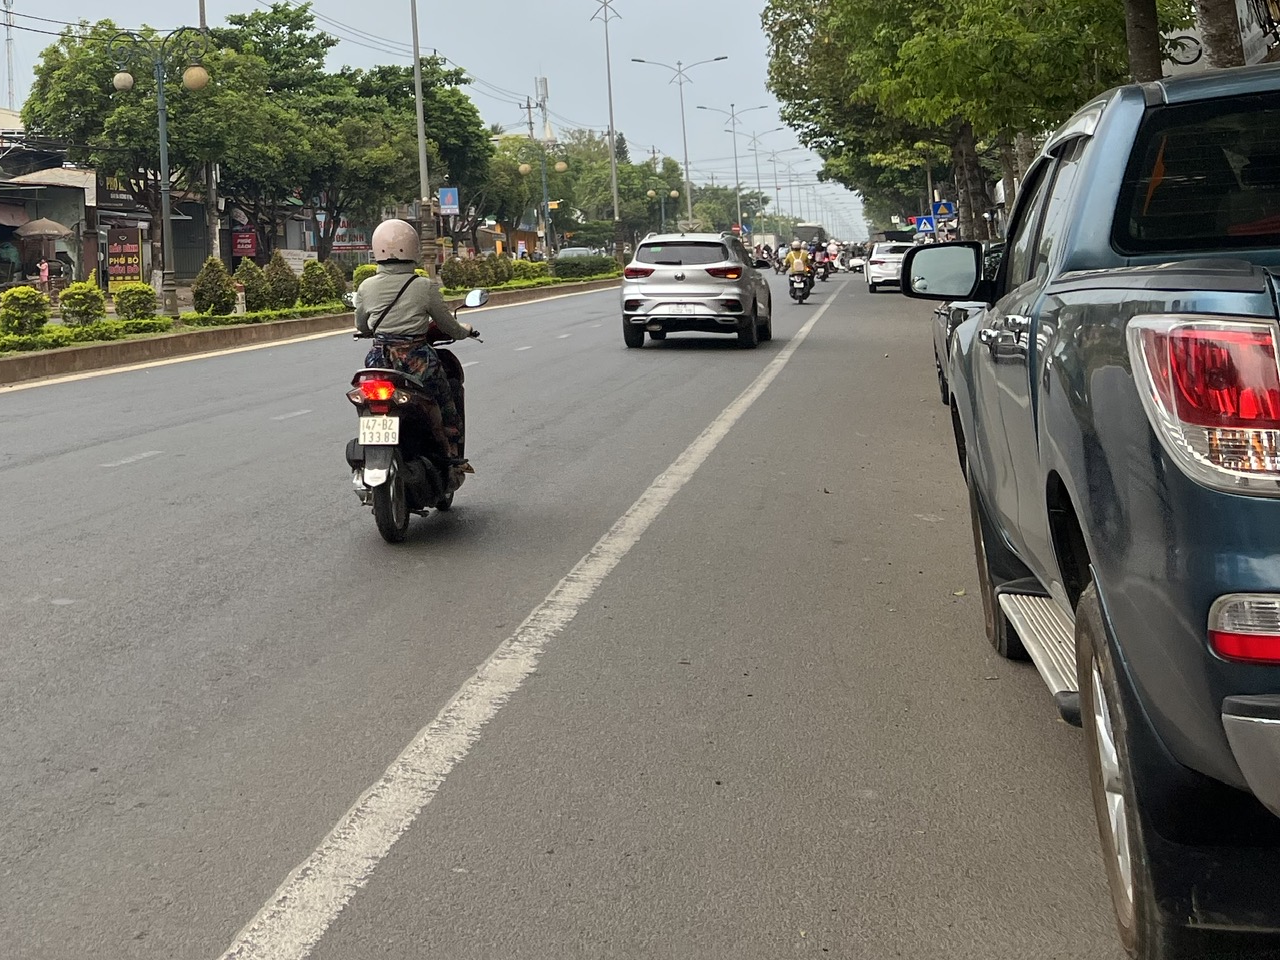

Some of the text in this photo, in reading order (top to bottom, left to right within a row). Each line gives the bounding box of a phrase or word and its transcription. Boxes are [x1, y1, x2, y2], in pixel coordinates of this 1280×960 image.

[109, 254, 139, 264] PHỞ BÒ
[366, 419, 394, 431] 47-B2
[362, 432, 397, 443] 133.89
